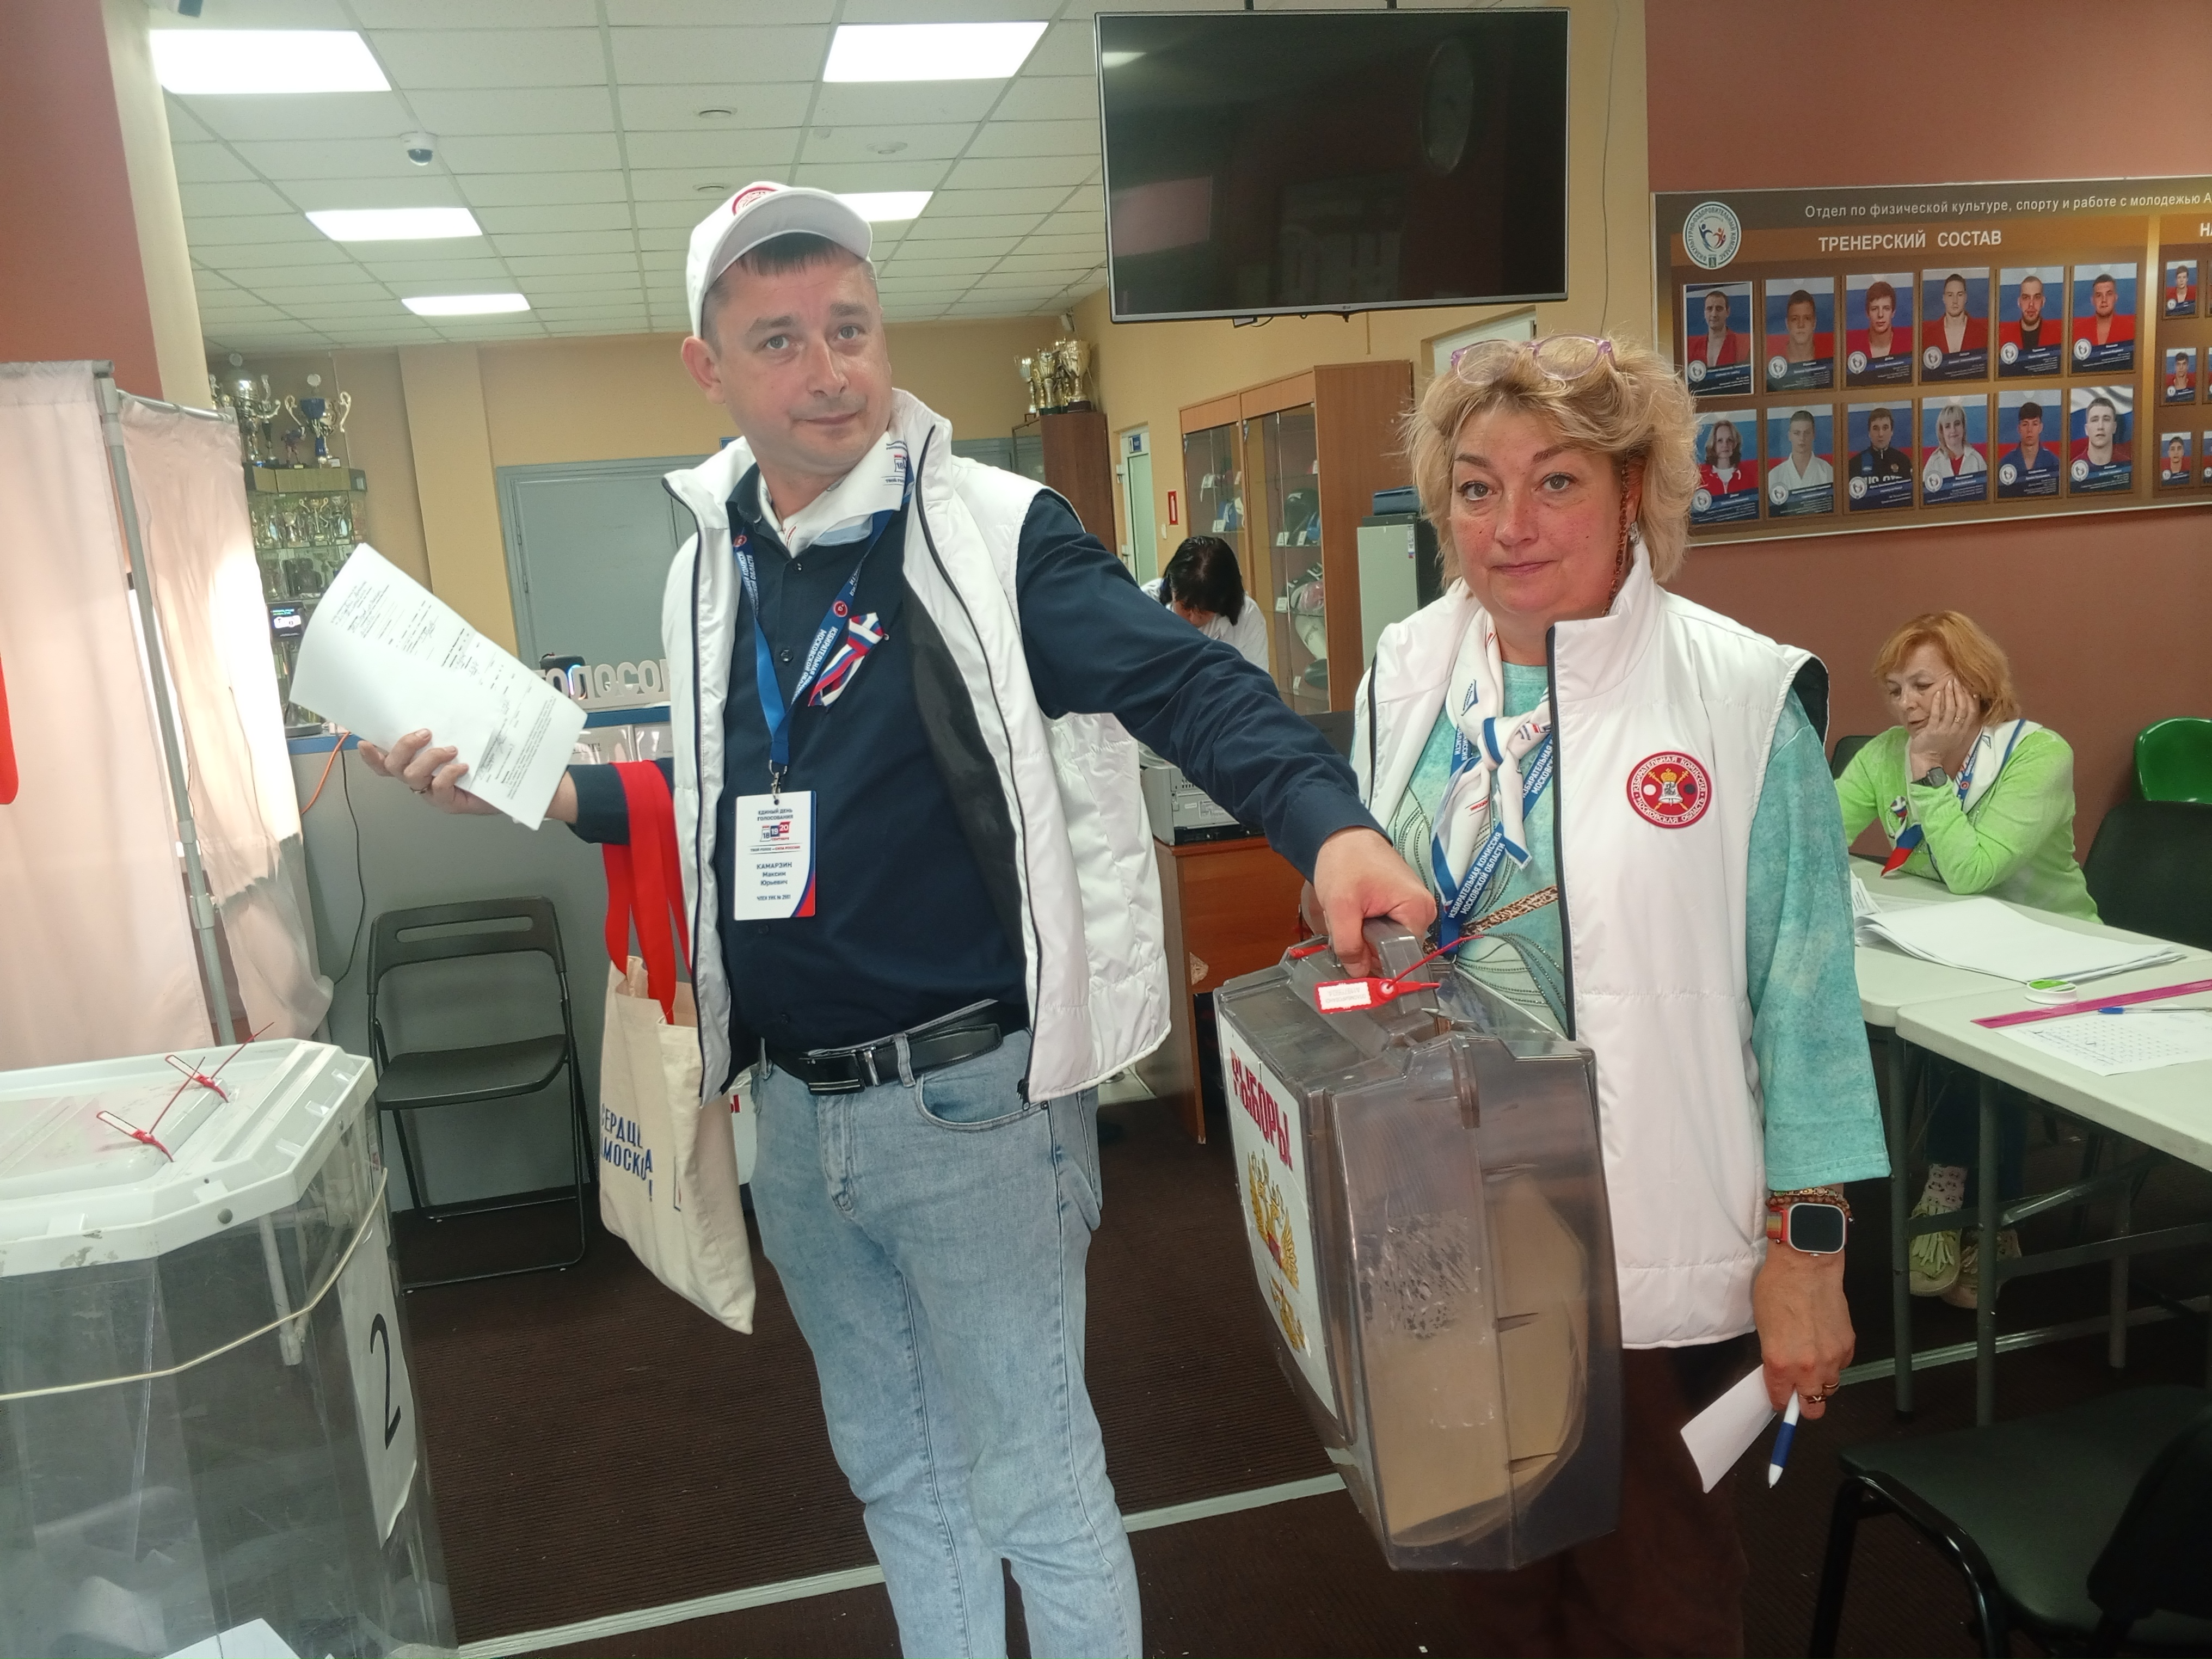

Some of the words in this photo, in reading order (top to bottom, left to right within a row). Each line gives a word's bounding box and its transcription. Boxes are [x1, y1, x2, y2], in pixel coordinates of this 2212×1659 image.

[1805, 205, 1846, 218] Отдел
[1851, 207, 1866, 216] по
[1870, 201, 1947, 217] физической
[1952, 200, 2012, 214] культуре,
[2016, 199, 2060, 212] спорту
[2062, 199, 2069, 208] и
[2073, 195, 2117, 211] работе
[2120, 196, 2127, 207] с
[2130, 194, 2201, 207] молодежью
[1818, 229, 1926, 252] ТРЕНЕРСКИЙ
[1937, 230, 2002, 247] СОСТАВ
[804, 629, 827, 672] МОСКОВСКОЙ
[809, 626, 839, 675] ИЗБИРАТЕЛЬНАЯ
[1633, 756, 1678, 792] ИЗБИРАТЕЛЬНАЯ
[1680, 758, 1706, 792] КОМИССИЯ
[1636, 797, 1679, 824] МОСКОВСКАЯ
[1681, 797, 1705, 822] ОБЛАСТЬ
[1448, 867, 1482, 918] ИЗБИРАТЕЛЬНАЯ
[1477, 832, 1503, 868] КОМИССИЯ
[1460, 871, 1489, 914] МОСКОВСКОЙ
[1484, 843, 1506, 873] ОБЛАСТИ
[1230, 1047, 1293, 1171] ВЫБОРЫ
[370, 1312, 402, 1451] 2
